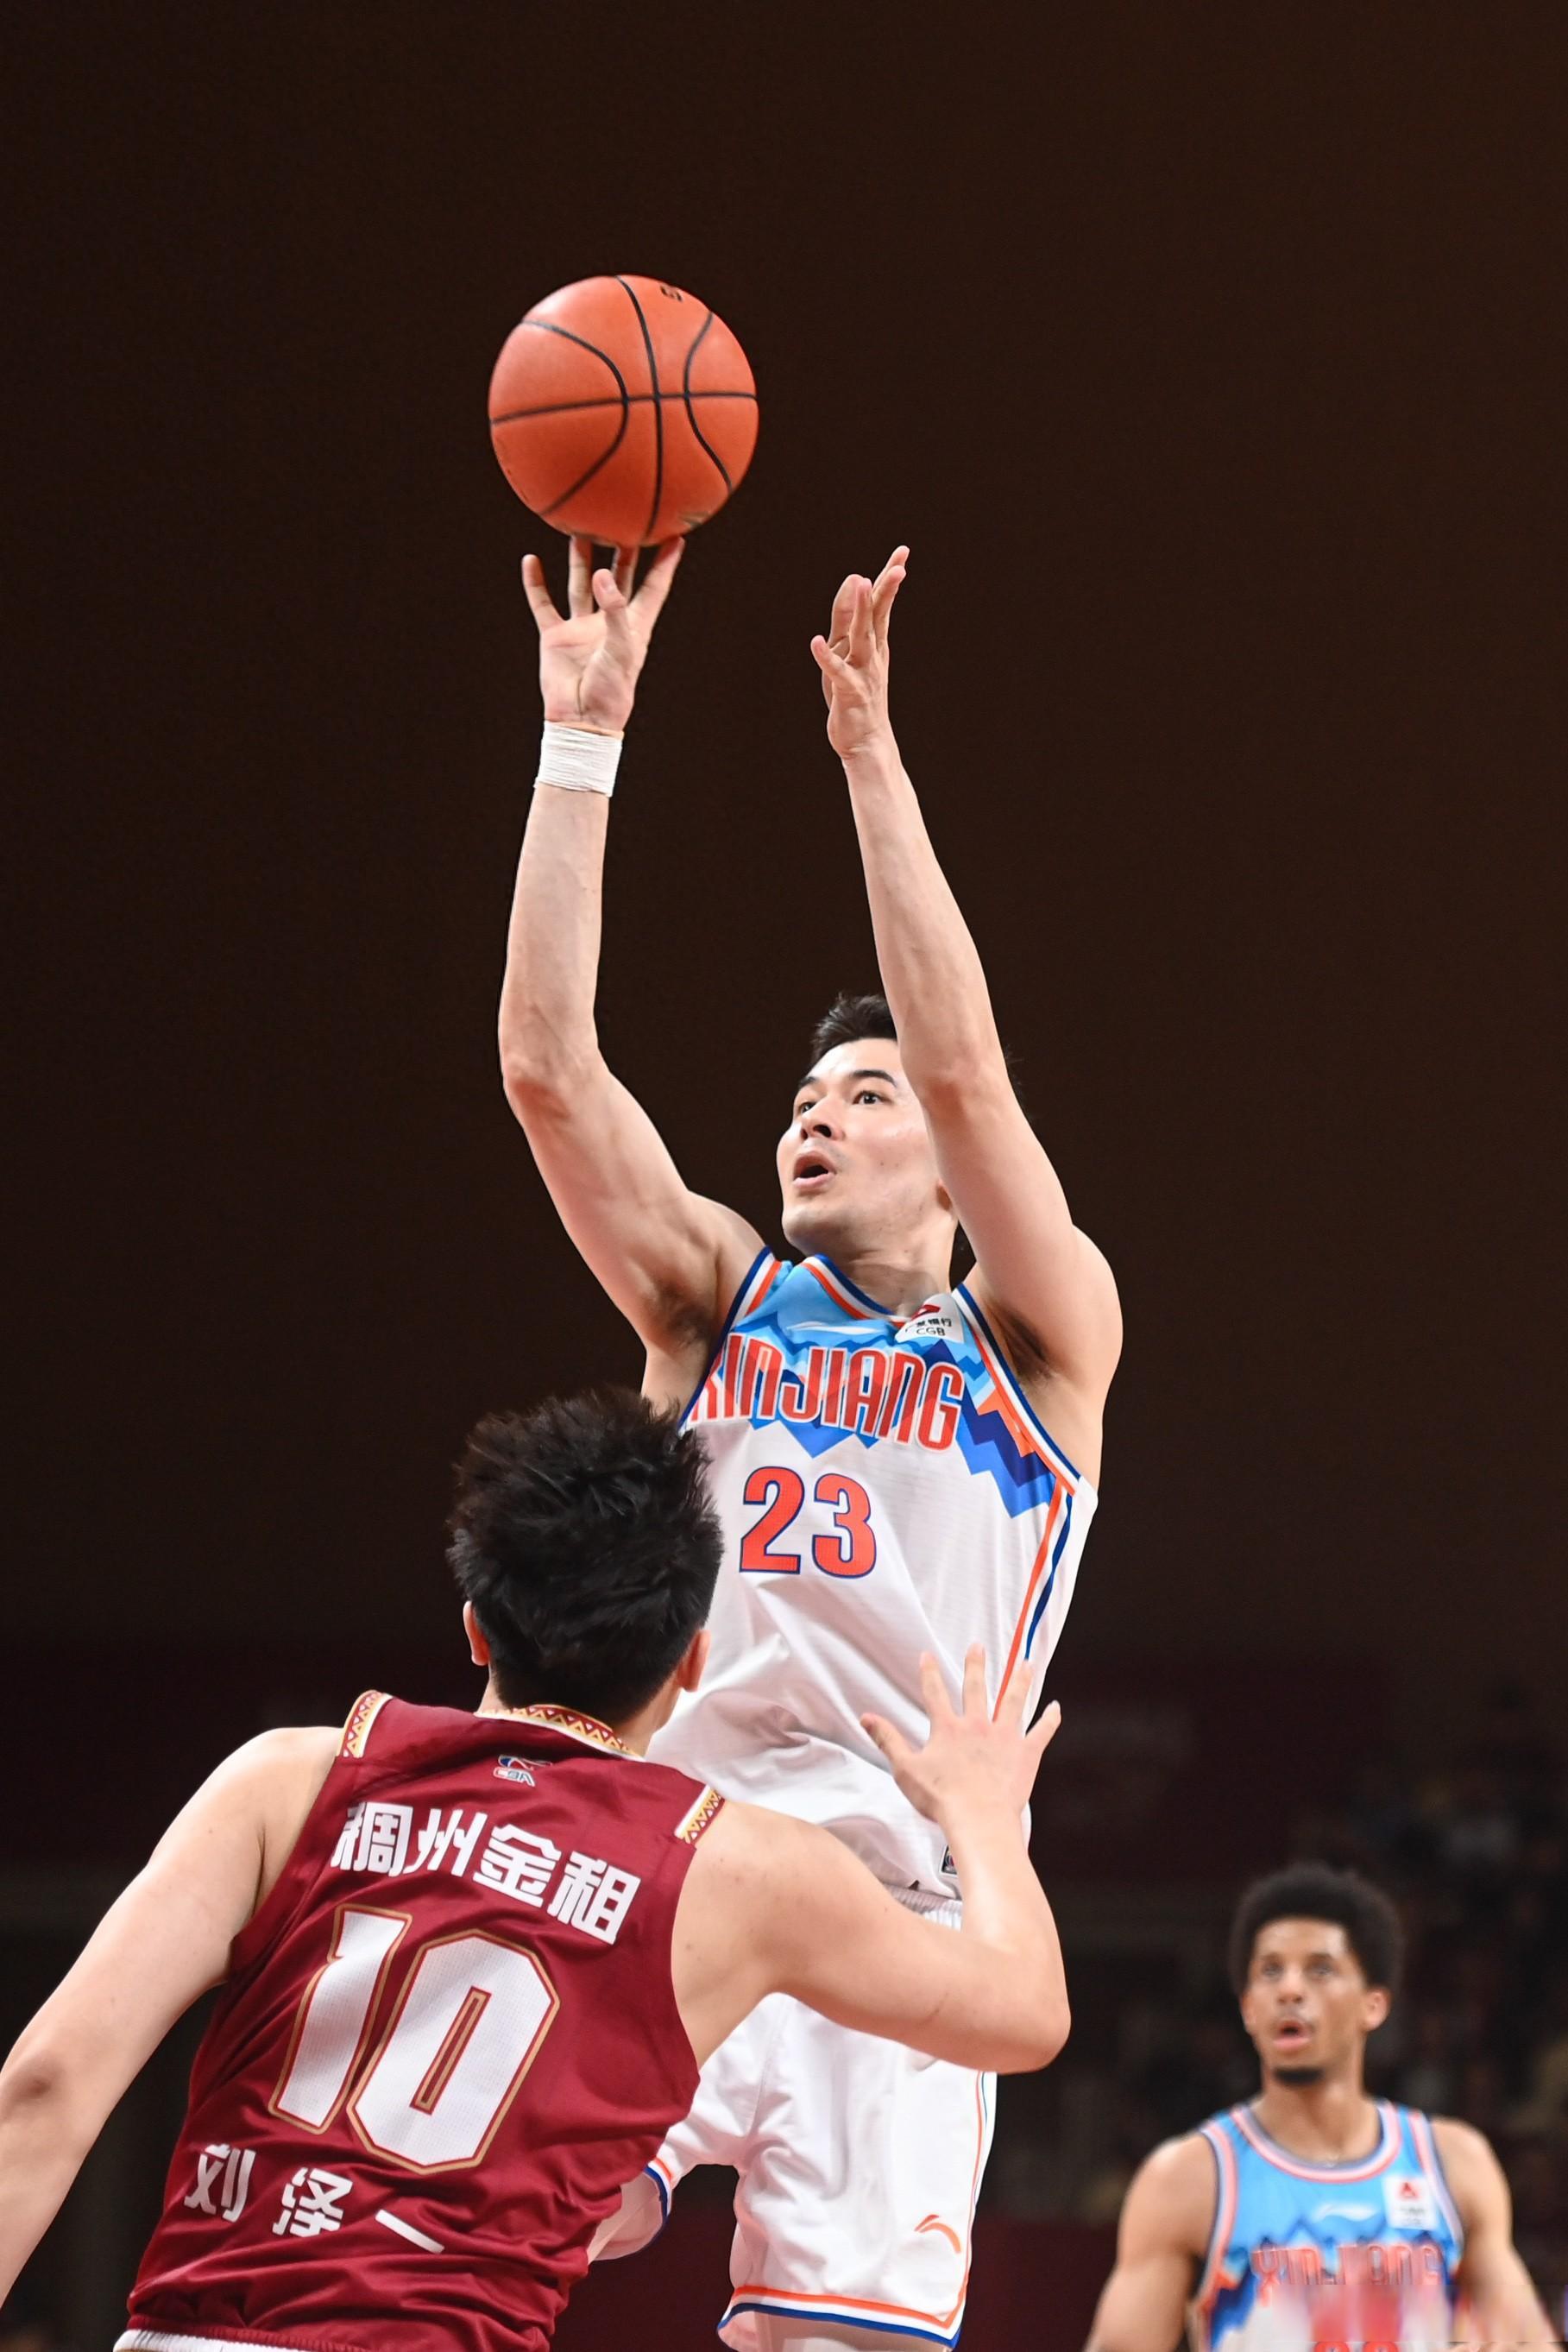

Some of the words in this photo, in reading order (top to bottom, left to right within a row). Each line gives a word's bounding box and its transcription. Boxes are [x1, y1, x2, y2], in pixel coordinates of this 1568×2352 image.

[916, 1327, 946, 1336] CGB
[740, 1466, 877, 1579] 23
[331, 1801, 642, 1945] 稠州金租
[268, 1904, 561, 2174] 10
[184, 2144, 445, 2254] 刘泽一
